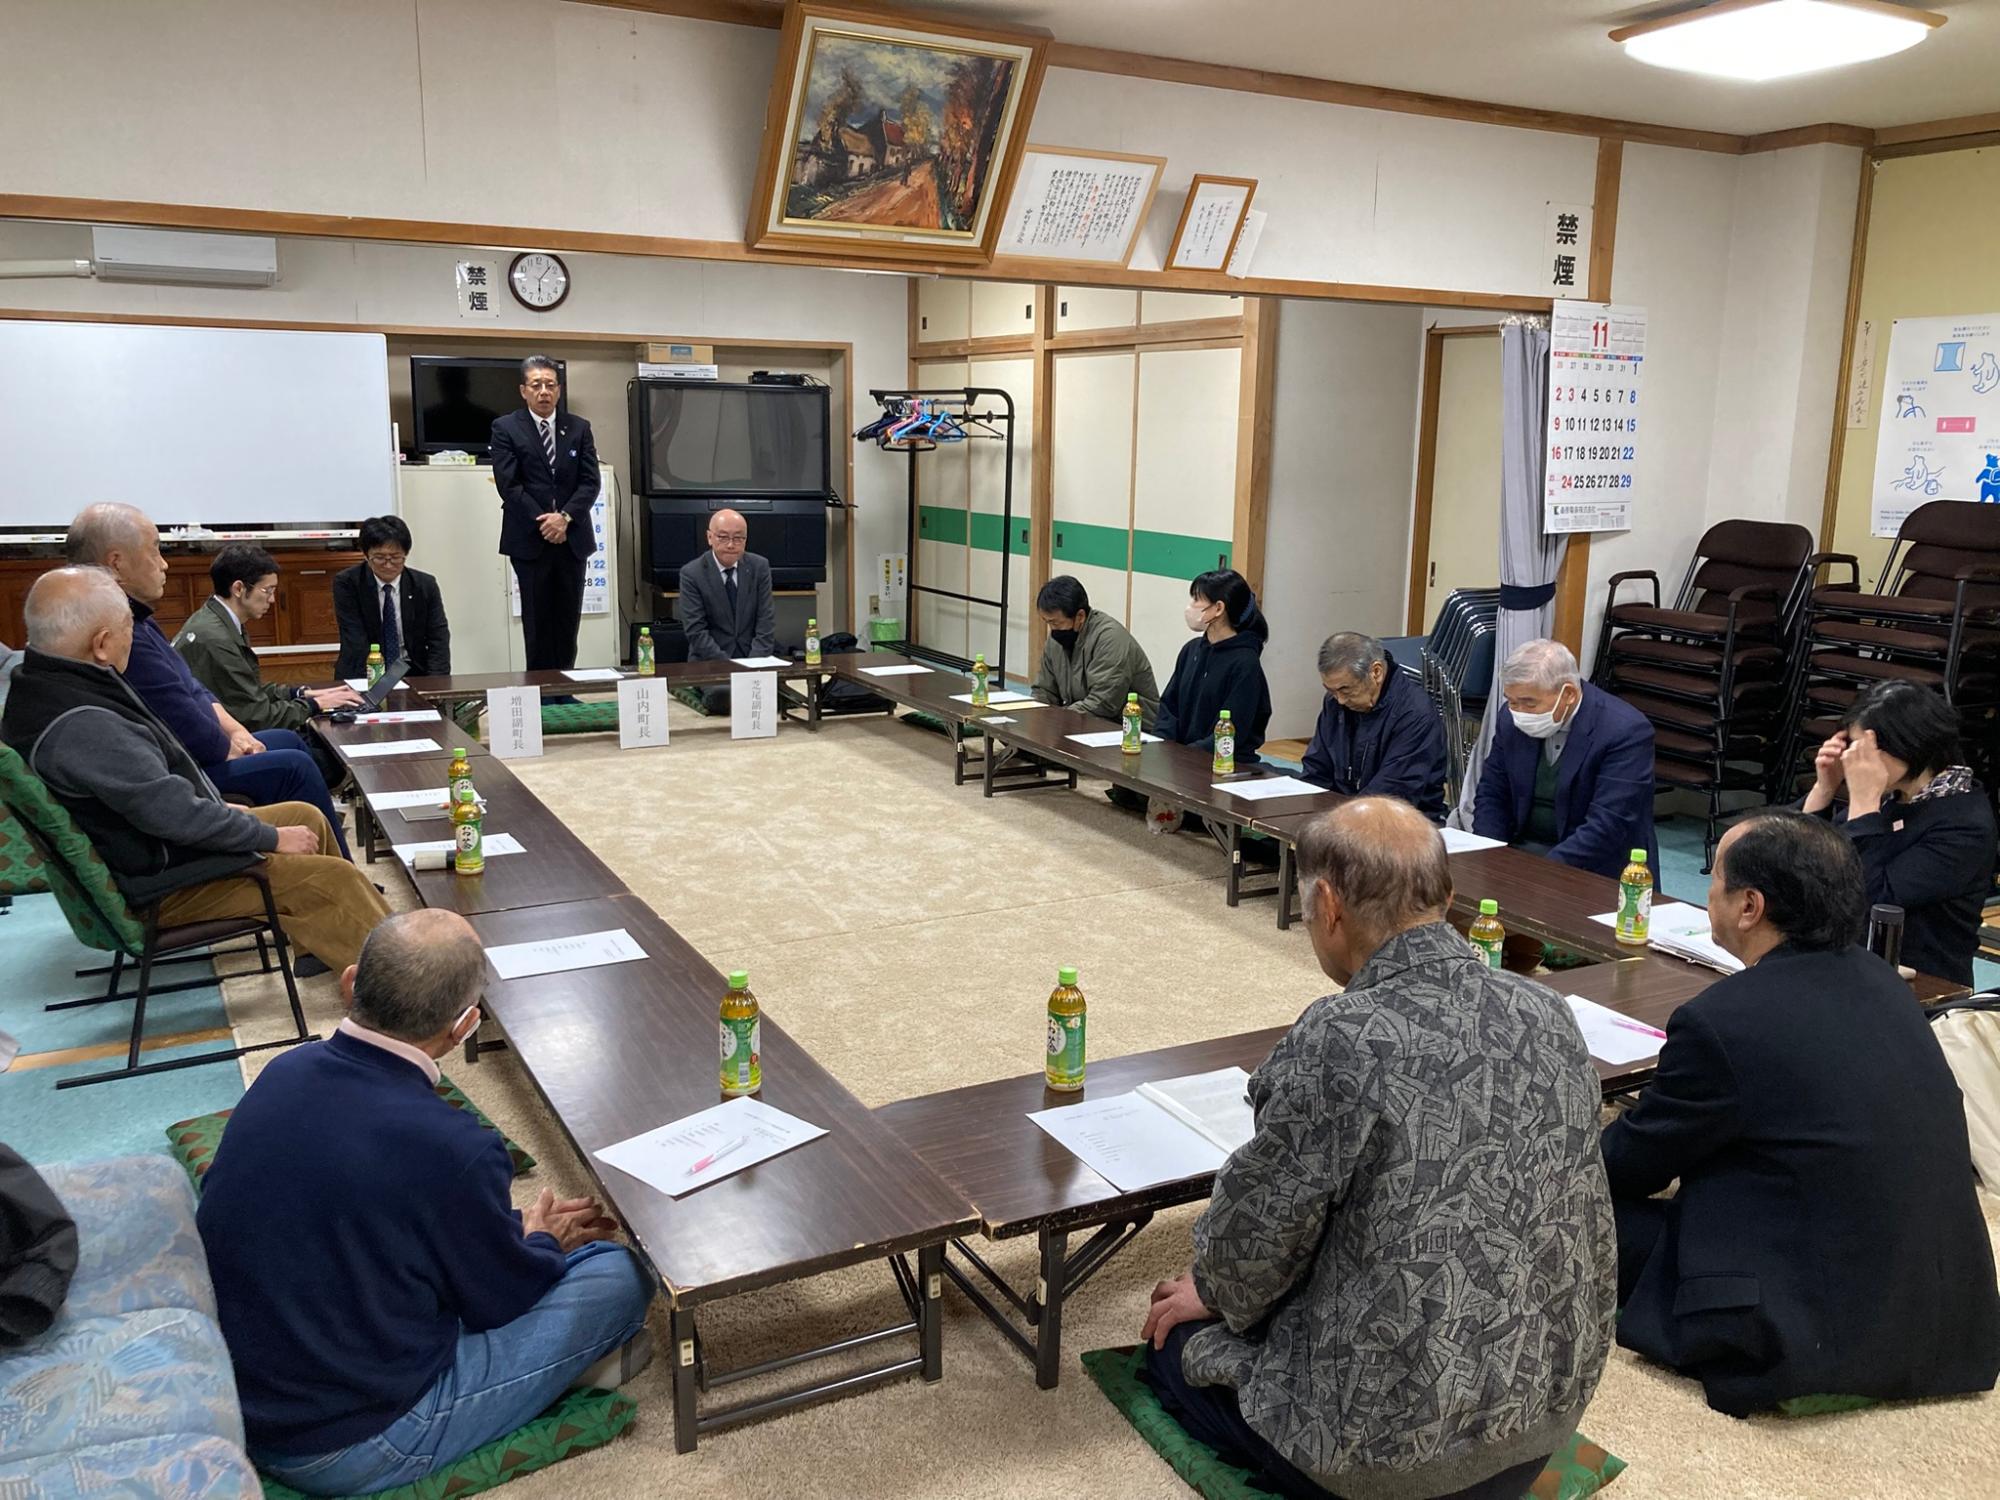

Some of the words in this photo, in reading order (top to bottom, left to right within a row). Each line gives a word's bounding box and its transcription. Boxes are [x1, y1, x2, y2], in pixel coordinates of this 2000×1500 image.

[1553, 213, 1579, 286] 禁煙
[467, 266, 488, 311] 禁煙
[1592, 321, 1608, 348] 11
[1556, 387, 1562, 401] 2
[1568, 388, 1574, 401] 3
[1581, 388, 1587, 402] 4
[1593, 389, 1599, 402] 5
[1605, 389, 1611, 403] 6
[1618, 390, 1624, 403] 7
[1630, 390, 1636, 403] 8
[1554, 417, 1560, 430] 9
[1565, 417, 1575, 430] 10
[1578, 417, 1586, 431] 11
[1590, 418, 1600, 431] 12
[1602, 418, 1611, 432] 13
[1614, 419, 1623, 432] 14
[1626, 419, 1636, 432] 15
[1551, 446, 1561, 459] 16
[1564, 446, 1573, 460] 17
[1576, 446, 1586, 460] 18
[1588, 446, 1598, 460] 19
[1599, 446, 1610, 460] 20
[1611, 446, 1620, 460] 21
[1622, 446, 1634, 460] 22
[1561, 475, 1572, 488] 24
[1574, 475, 1584, 488] 25
[1586, 475, 1596, 488] 26
[1597, 475, 1608, 488] 27
[1609, 474, 1620, 488] 28
[1621, 474, 1632, 488] 29
[595, 525, 601, 533] 8
[594, 560, 605, 569] 22
[594, 578, 606, 587] 29
[637, 688, 651, 738] 山内町長
[462, 825, 472, 850] お茶
